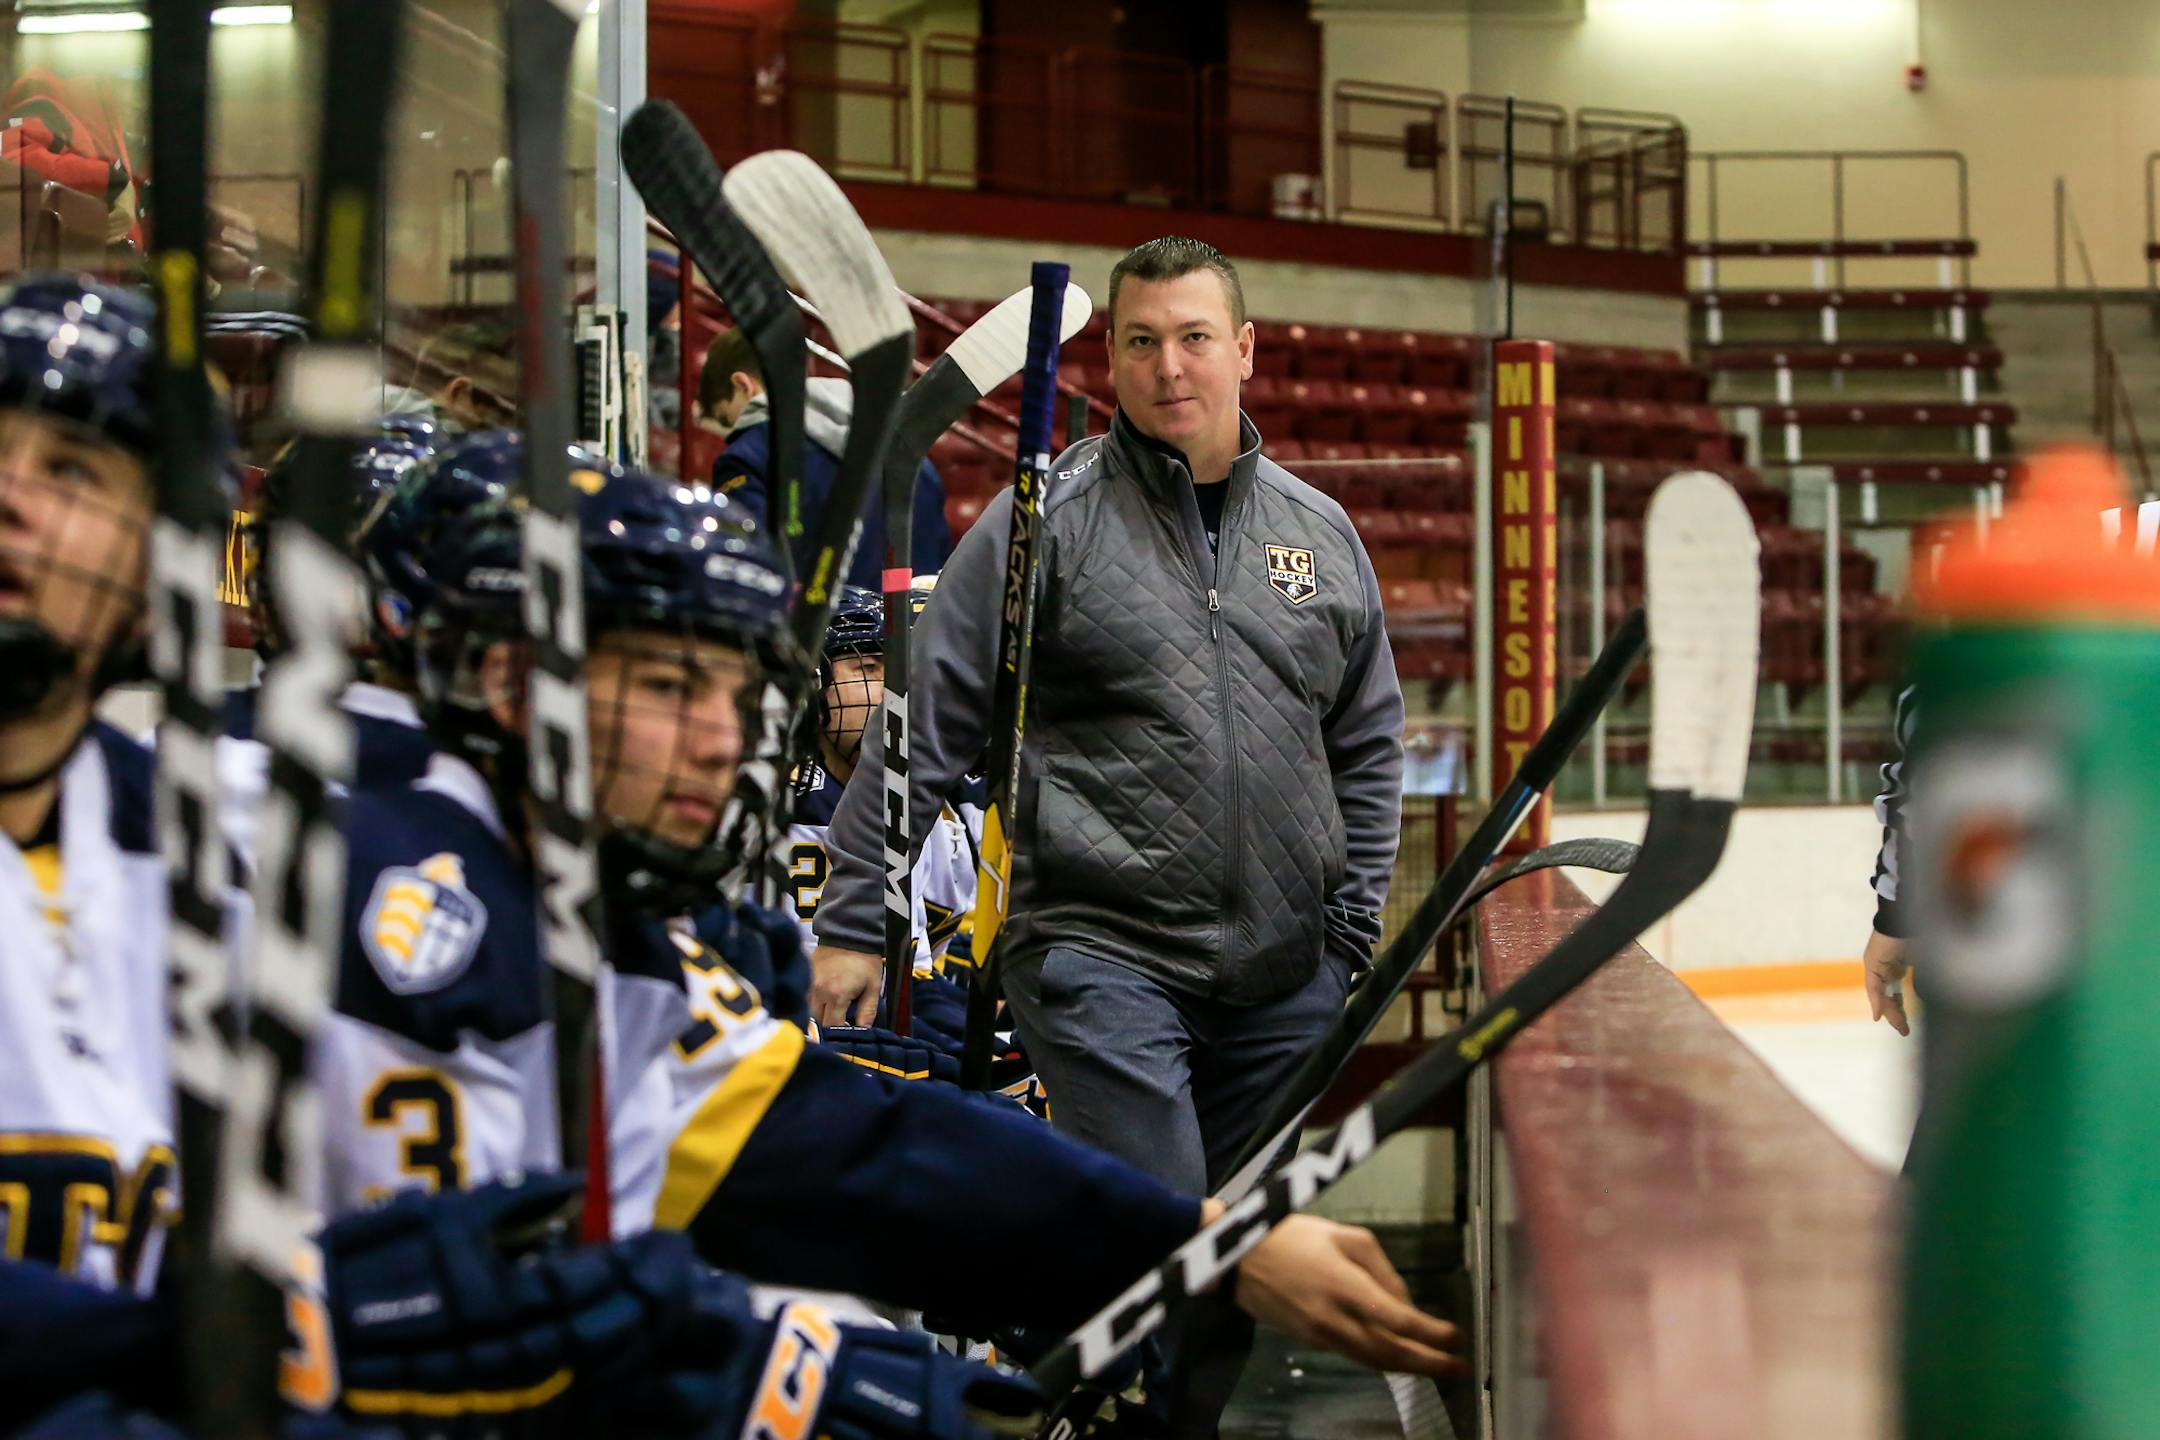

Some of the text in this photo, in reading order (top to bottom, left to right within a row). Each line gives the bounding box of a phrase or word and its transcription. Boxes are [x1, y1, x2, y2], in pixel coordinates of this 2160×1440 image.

[1057, 451, 1099, 480] CCM
[1269, 548, 1310, 574] TG
[1270, 570, 1314, 585] HOCKEY
[1497, 363, 1532, 840] MINNESOT
[884, 687, 909, 922] CCM
[1064, 1102, 1377, 1379] CCM
